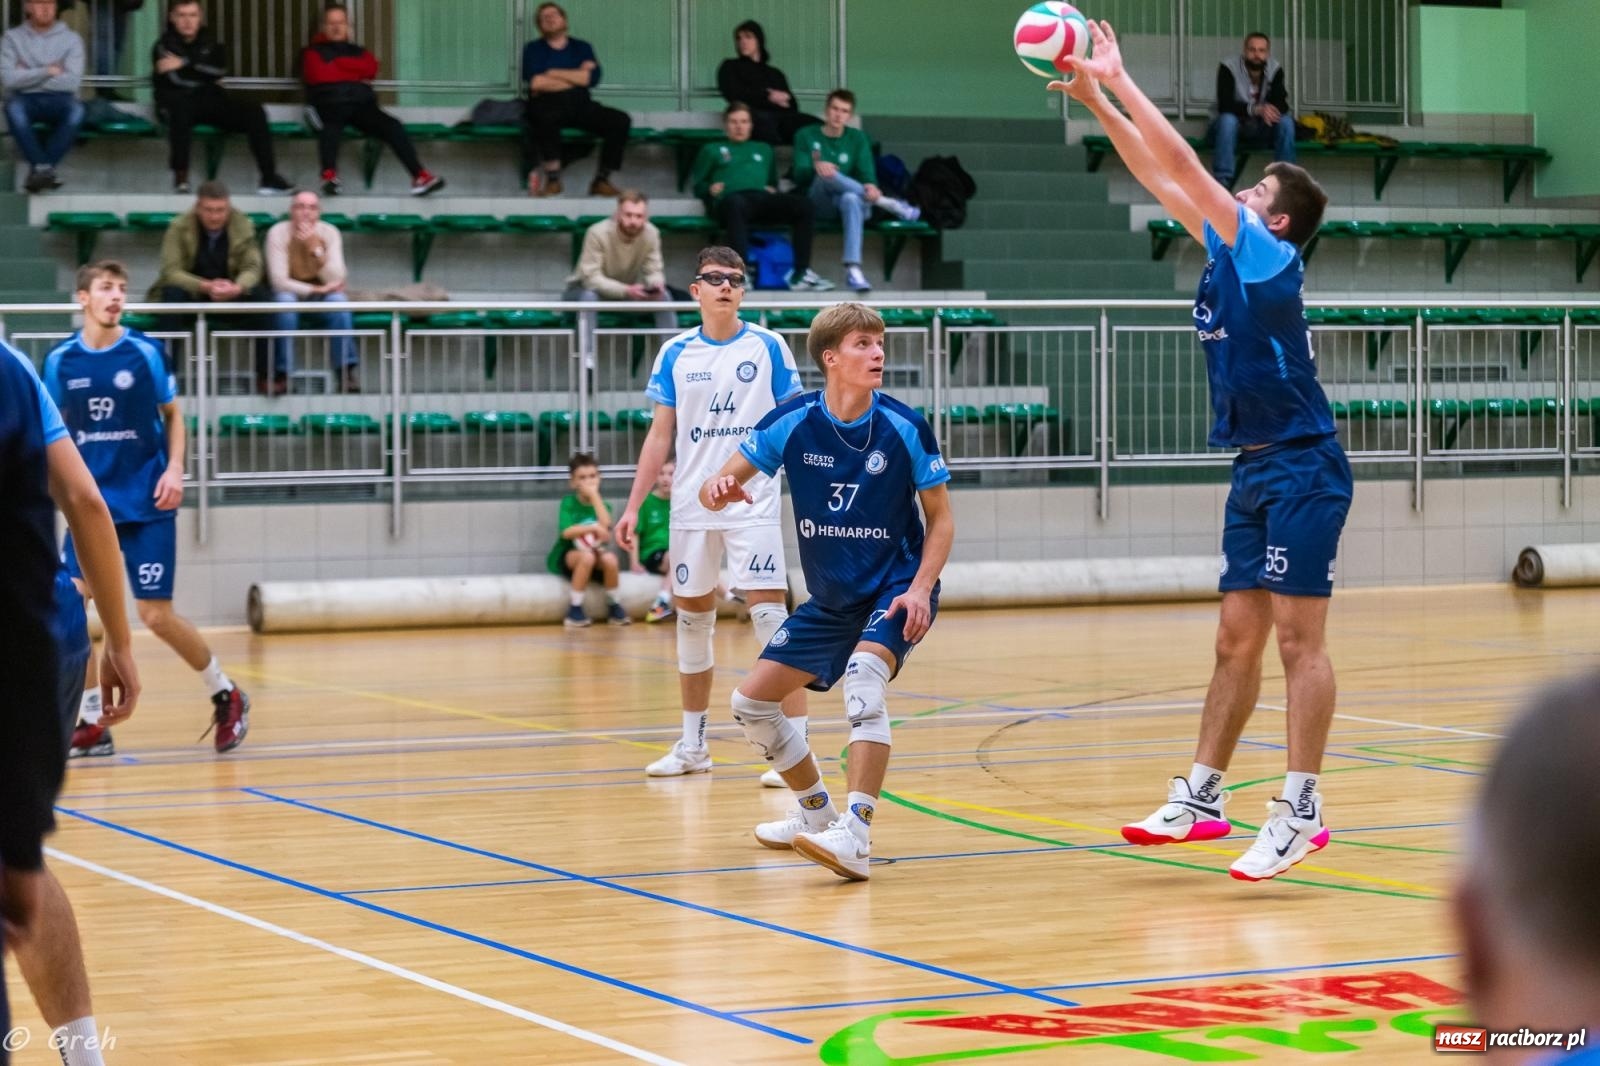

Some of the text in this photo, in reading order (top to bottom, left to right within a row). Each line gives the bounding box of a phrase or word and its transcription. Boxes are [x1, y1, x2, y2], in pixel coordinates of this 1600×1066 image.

[88, 397, 115, 421] 59
[709, 390, 736, 415] 44
[703, 426, 753, 438] HEMARPO
[828, 482, 860, 512] 37
[818, 524, 890, 539] HEMARPOL
[748, 554, 776, 573] 44
[1265, 545, 1288, 574] 55
[138, 562, 164, 585] 59
[1297, 778, 1316, 812] NORWID
